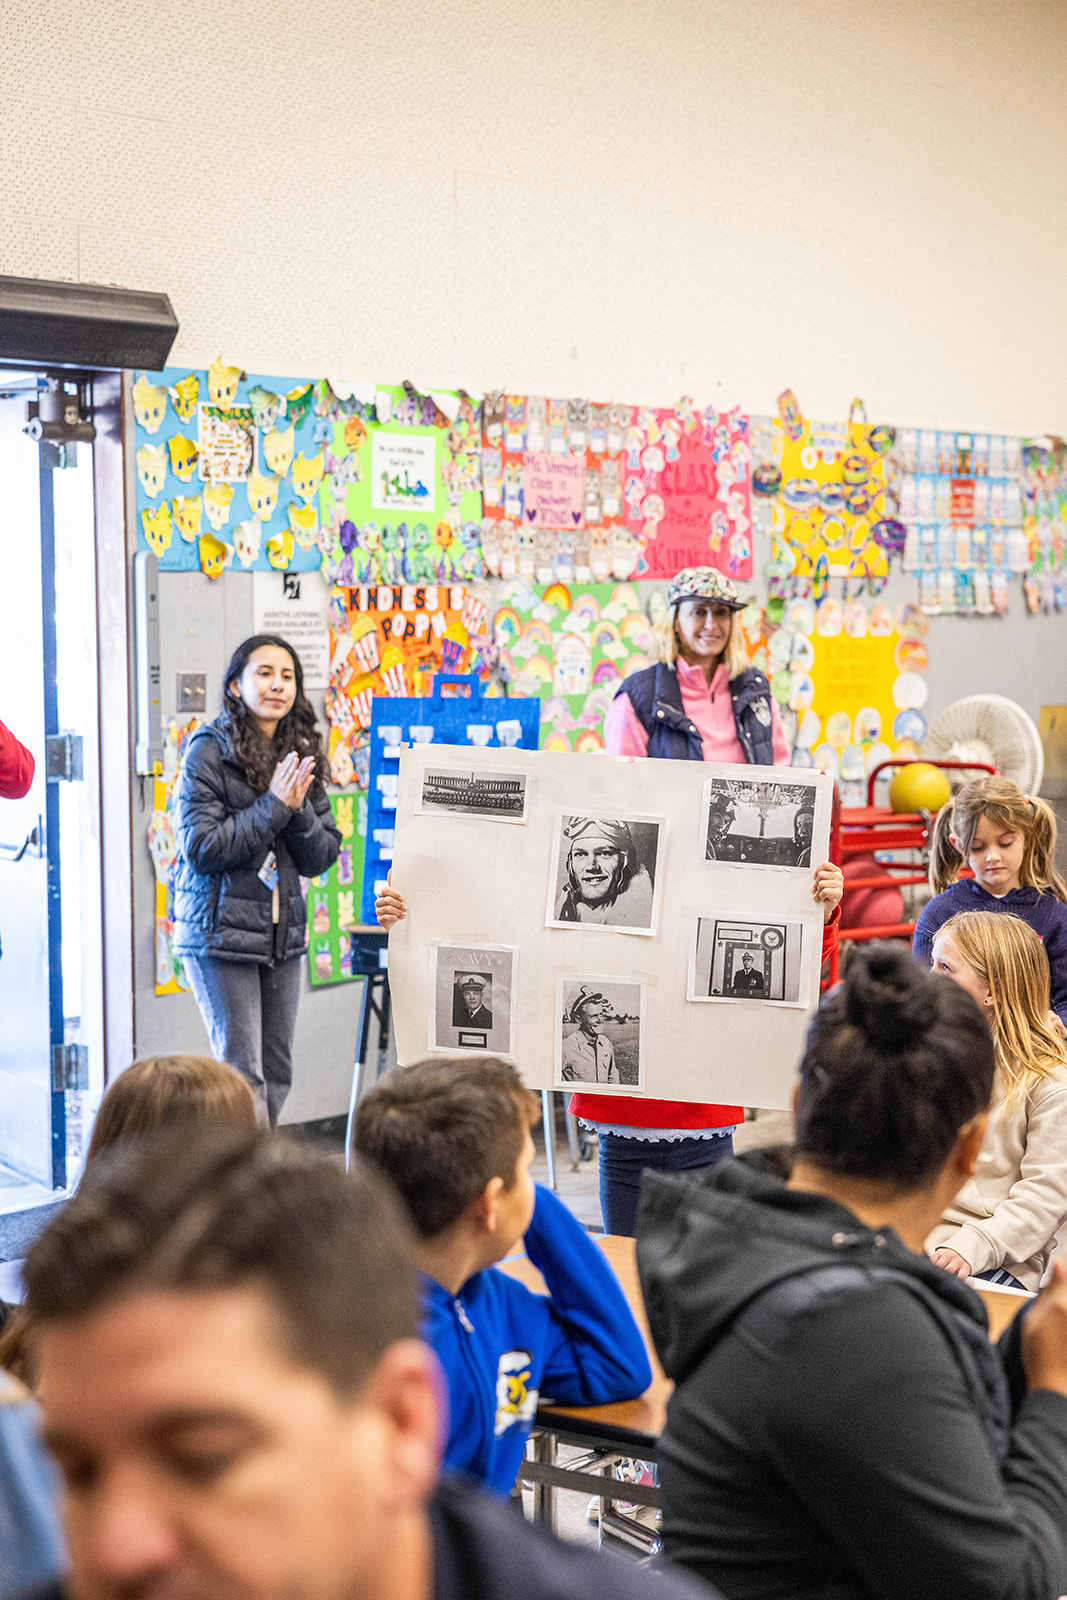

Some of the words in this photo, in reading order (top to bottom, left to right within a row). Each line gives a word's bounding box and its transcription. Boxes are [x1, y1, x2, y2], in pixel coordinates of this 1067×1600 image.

[349, 586, 439, 612] KINDNESS
[447, 586, 464, 612] IS
[455, 951, 495, 967] NAVY
